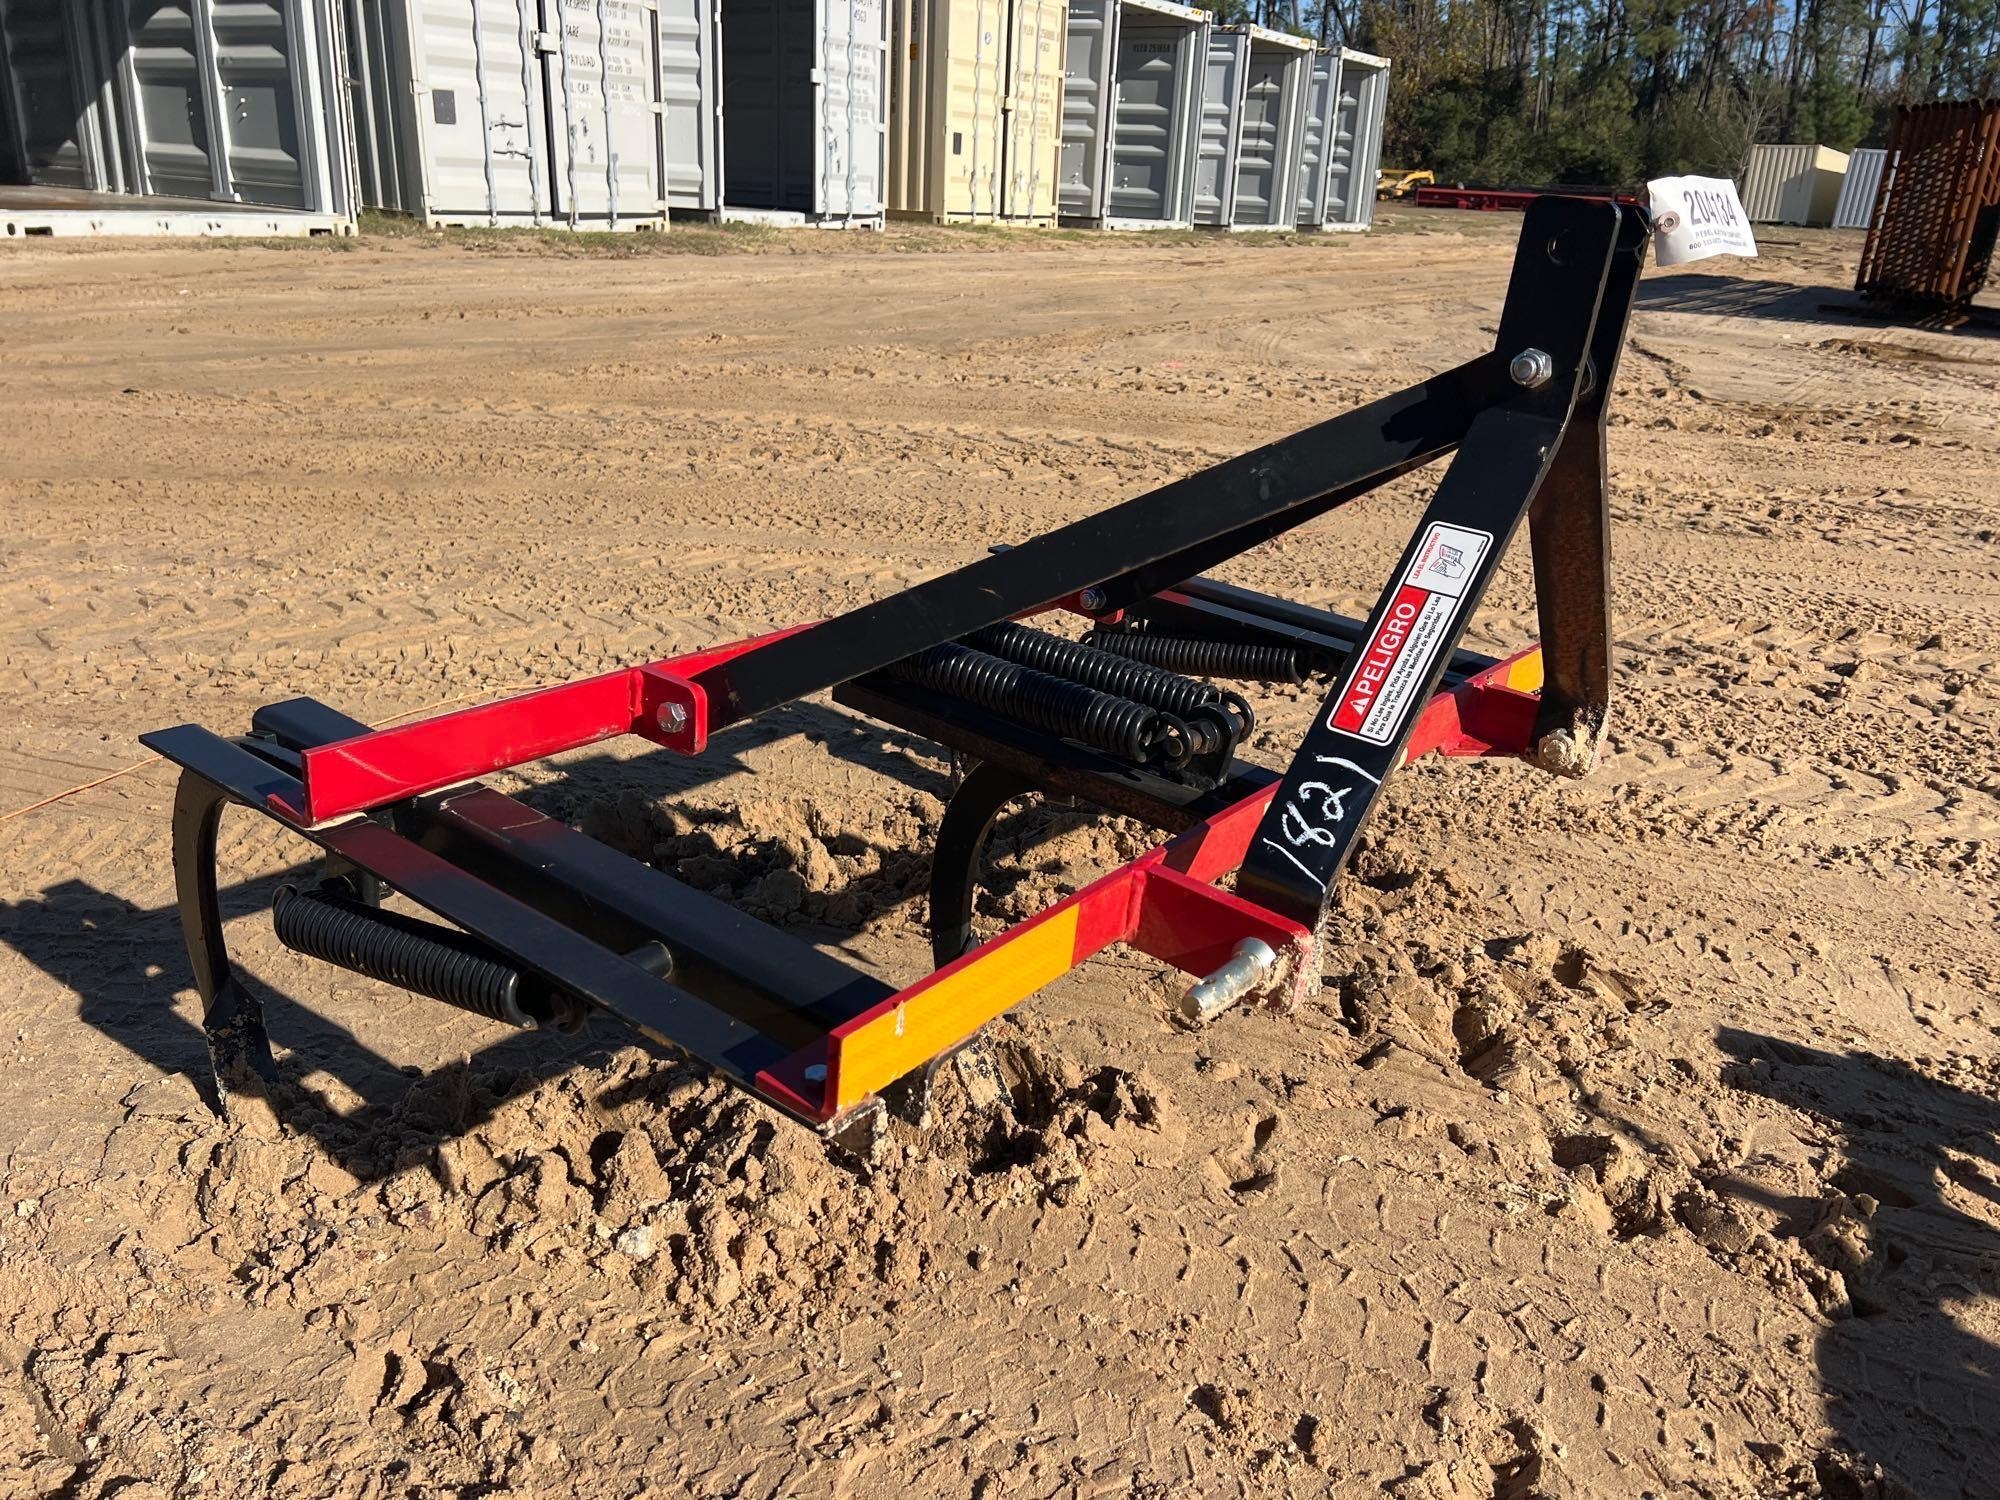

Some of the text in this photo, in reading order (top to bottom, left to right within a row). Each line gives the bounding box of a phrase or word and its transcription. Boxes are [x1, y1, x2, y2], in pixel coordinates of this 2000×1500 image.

[565, 24, 579, 37] TARE
[1413, 568, 1421, 579] LEA
[1421, 532, 1440, 562] INSTRUCTIVO
[1431, 596, 1441, 606] Lea
[1427, 605, 1436, 614] Lo
[1419, 621, 1429, 633] Que
[1356, 603, 1415, 694] PELIGRO
[1408, 632, 1422, 654] Alguien
[1397, 658, 1411, 676] Ayuda
[1375, 722, 1385, 736] Para
[1382, 710, 1392, 722] Que
[1391, 679, 1408, 703] Traduzca
[1404, 670, 1412, 679] las
[1409, 648, 1424, 670] Medidas
[1424, 612, 1443, 640] Seguridad.
[1390, 675, 1401, 688] Pida
[1375, 705, 1385, 717] Lee
[1370, 717, 1379, 726] No
[1263, 753, 1381, 893] 1821
